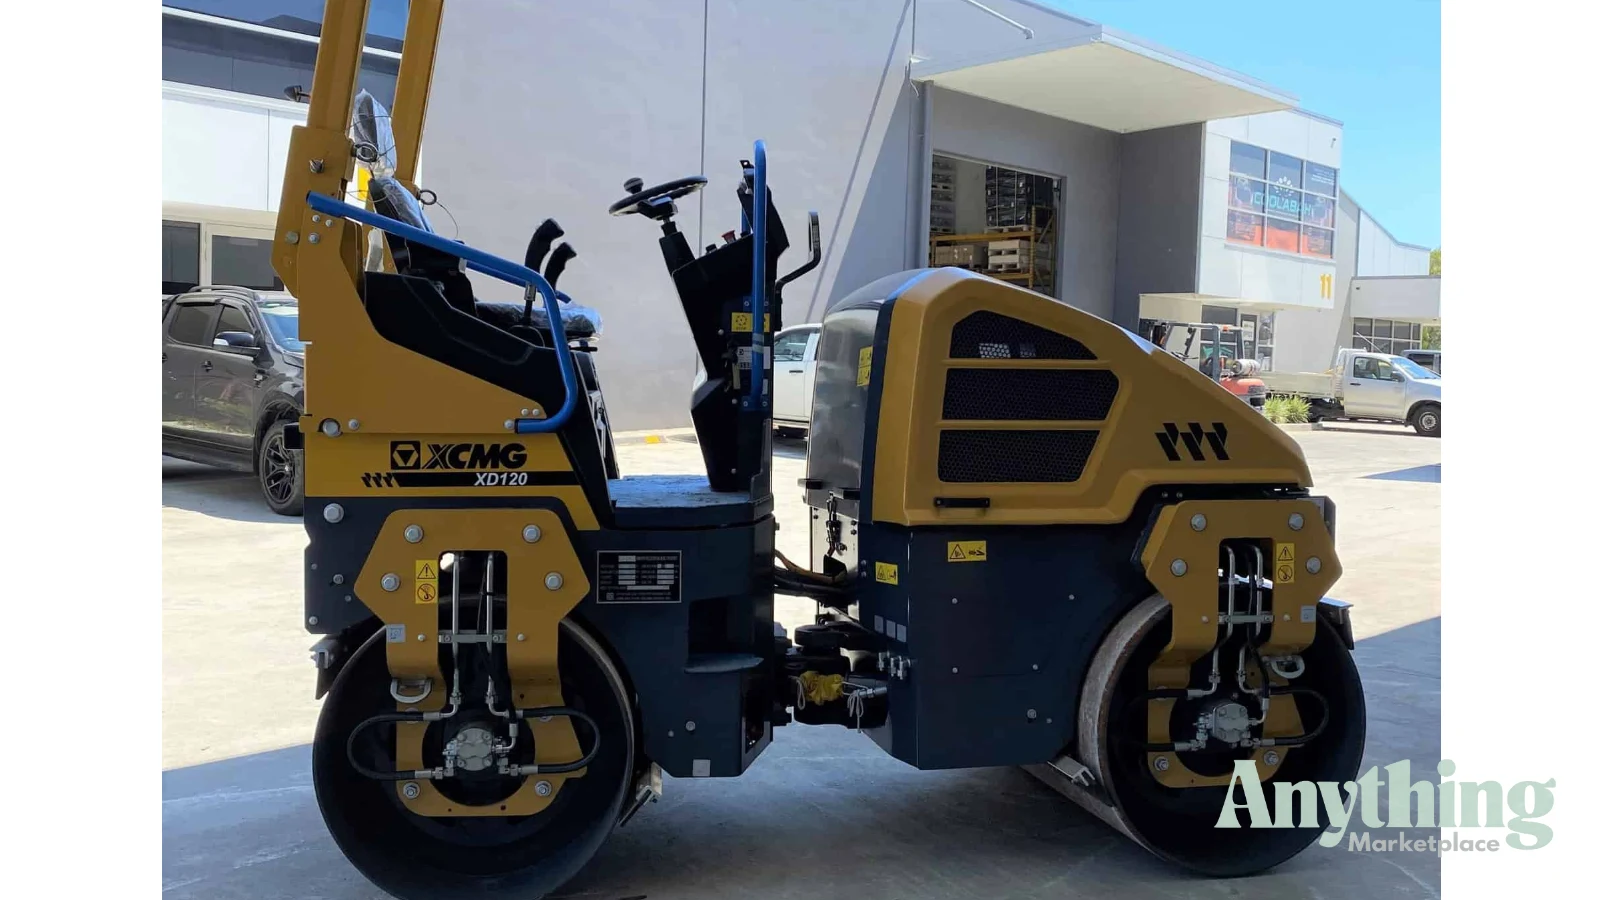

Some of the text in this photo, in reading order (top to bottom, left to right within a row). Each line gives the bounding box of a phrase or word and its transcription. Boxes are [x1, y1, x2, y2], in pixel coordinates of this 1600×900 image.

[1254, 191, 1311, 215] COLABH
[1320, 274, 1332, 300] 11
[423, 443, 527, 470] XCMG
[474, 473, 528, 486] XD120
